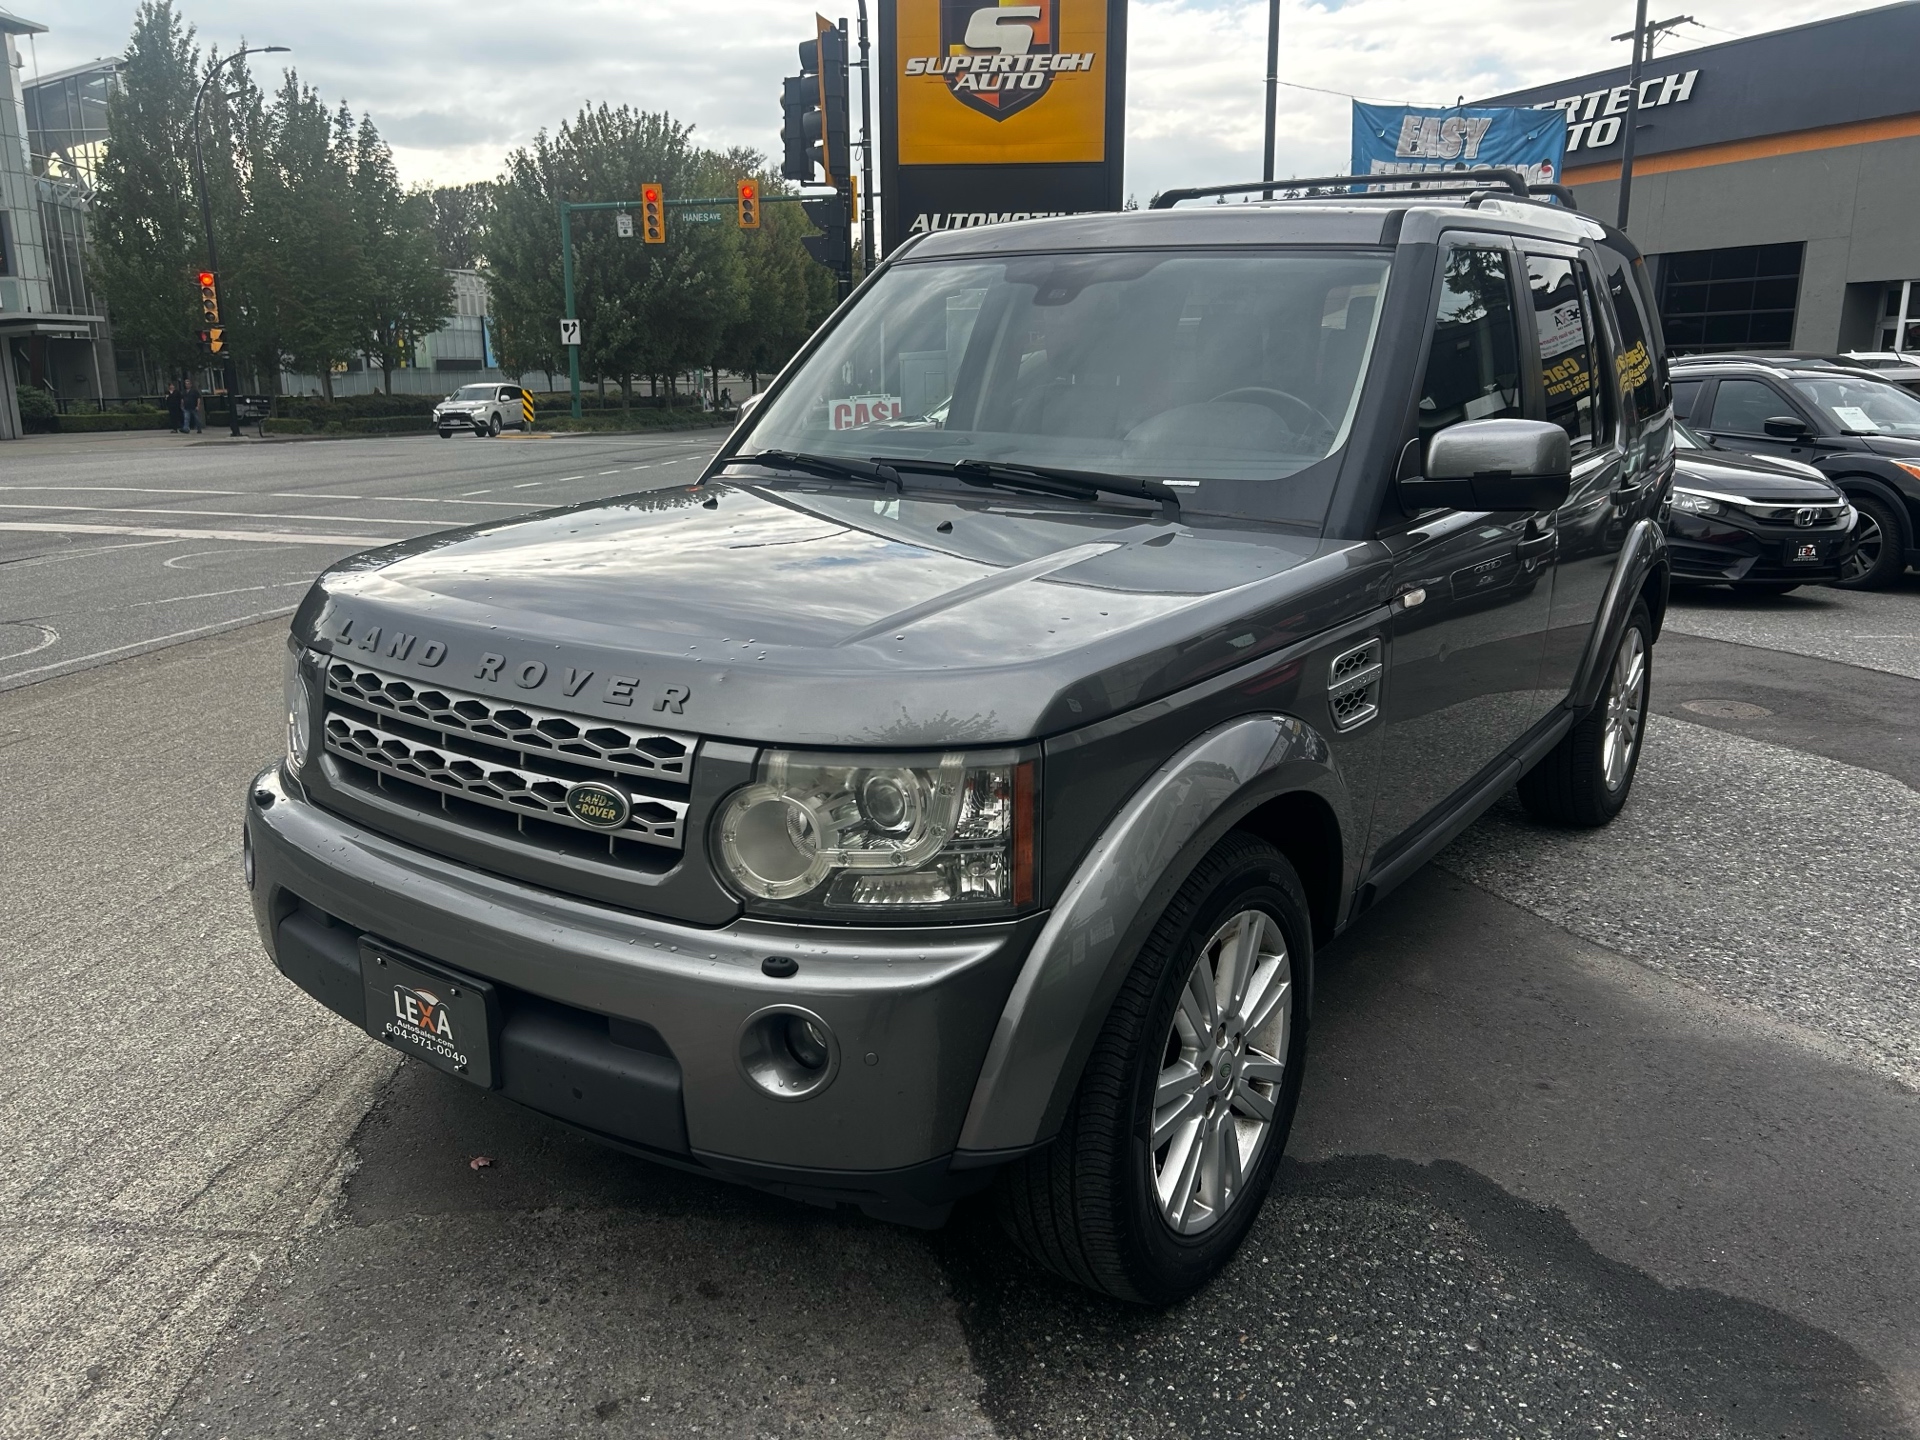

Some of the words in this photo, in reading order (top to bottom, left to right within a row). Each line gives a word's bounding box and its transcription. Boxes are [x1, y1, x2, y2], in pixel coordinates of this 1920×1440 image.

[904, 53, 1095, 76] SUPERTECH
[953, 72, 1045, 91] AUTO
[1533, 69, 1700, 124] RTECH
[1395, 114, 1493, 159] EASY
[1566, 116, 1621, 152] TO
[682, 213, 709, 221] HANES
[1798, 548, 1816, 556] LEXA
[335, 618, 449, 669] LAND
[474, 651, 691, 715] ROVER
[578, 792, 607, 806] LAND
[581, 803, 616, 820] ROVER
[393, 990, 454, 1040] LEXA
[386, 1022, 468, 1065] 604-971-0040
[397, 1019, 455, 1050] AutoSales.com
